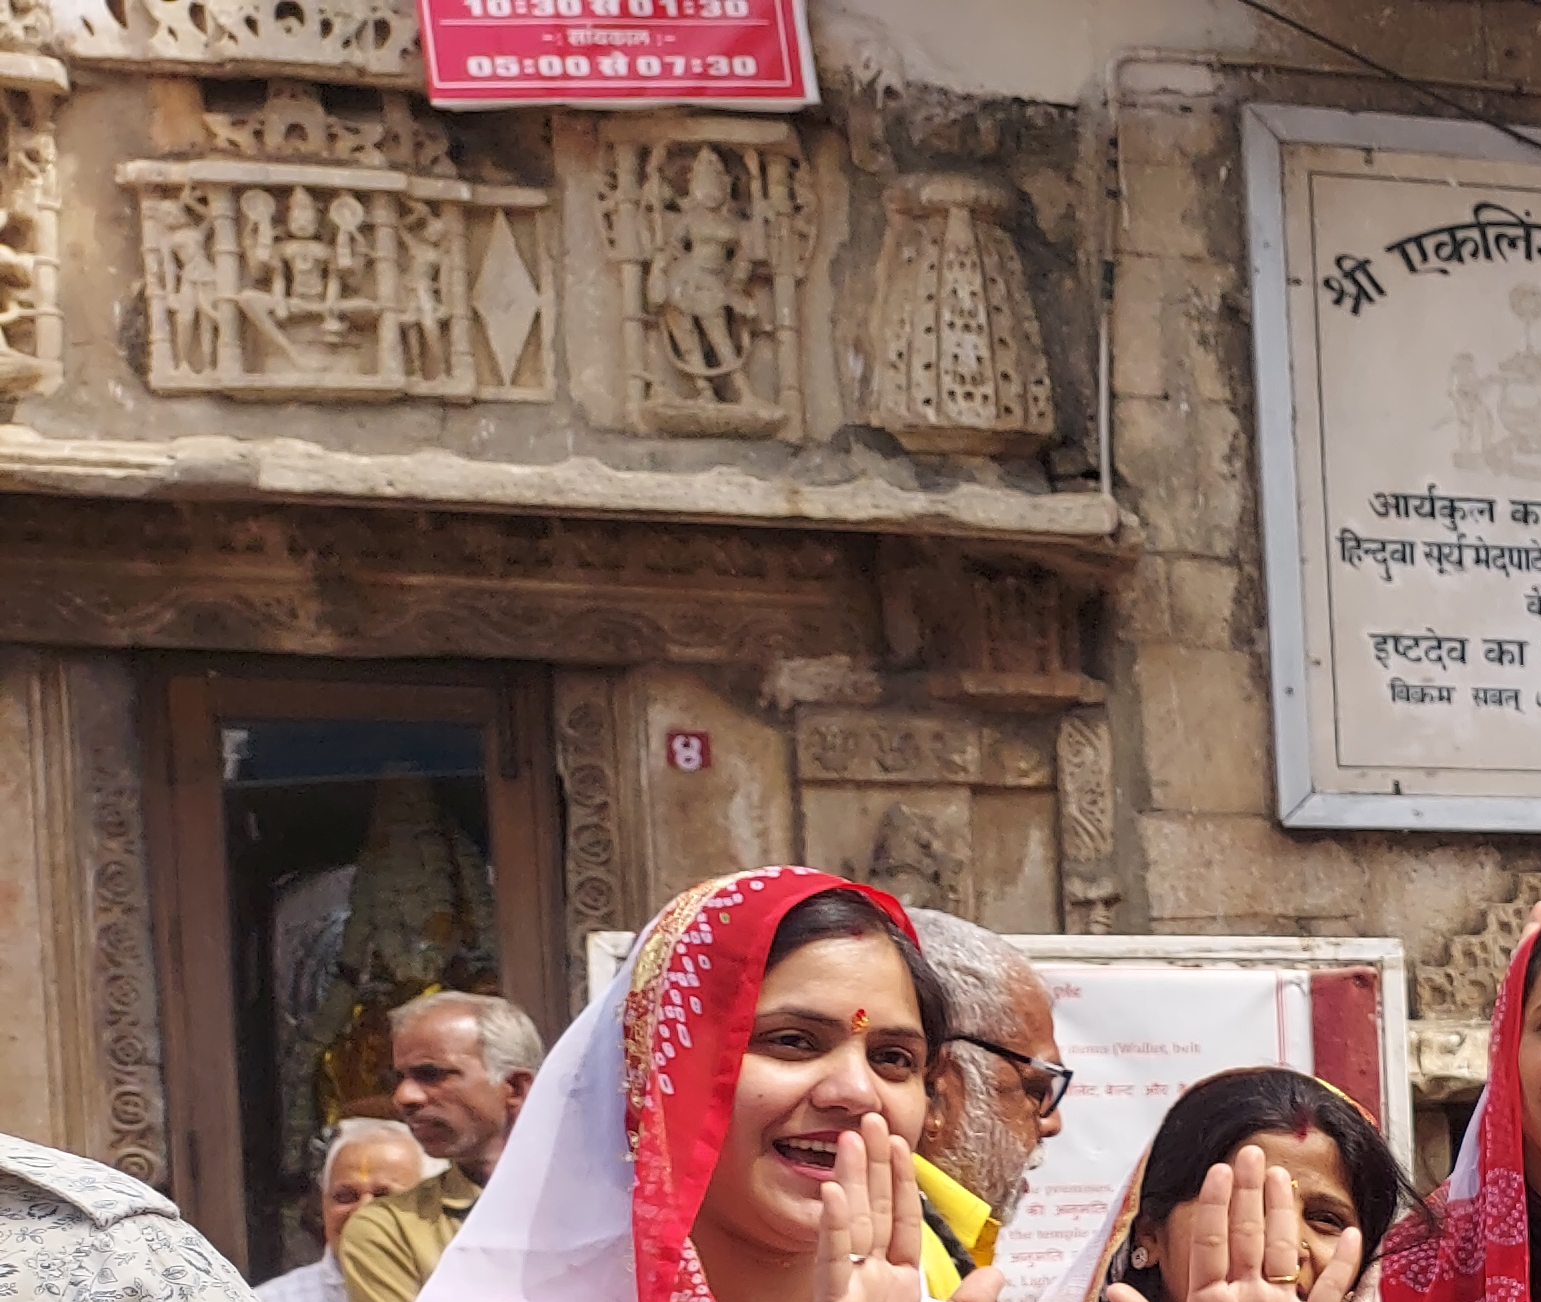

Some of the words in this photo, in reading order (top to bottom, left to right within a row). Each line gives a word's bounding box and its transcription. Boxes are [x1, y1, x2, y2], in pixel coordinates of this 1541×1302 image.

[467, 55, 590, 78] 05:00
[636, 55, 757, 77] 07:30
[1323, 253, 1387, 316] श्री
[1368, 483, 1497, 532] आर्यकुल
[1336, 527, 1416, 582] हिन्दुवा
[1367, 627, 1470, 671] इष्टदेव
[1481, 638, 1530, 666] का
